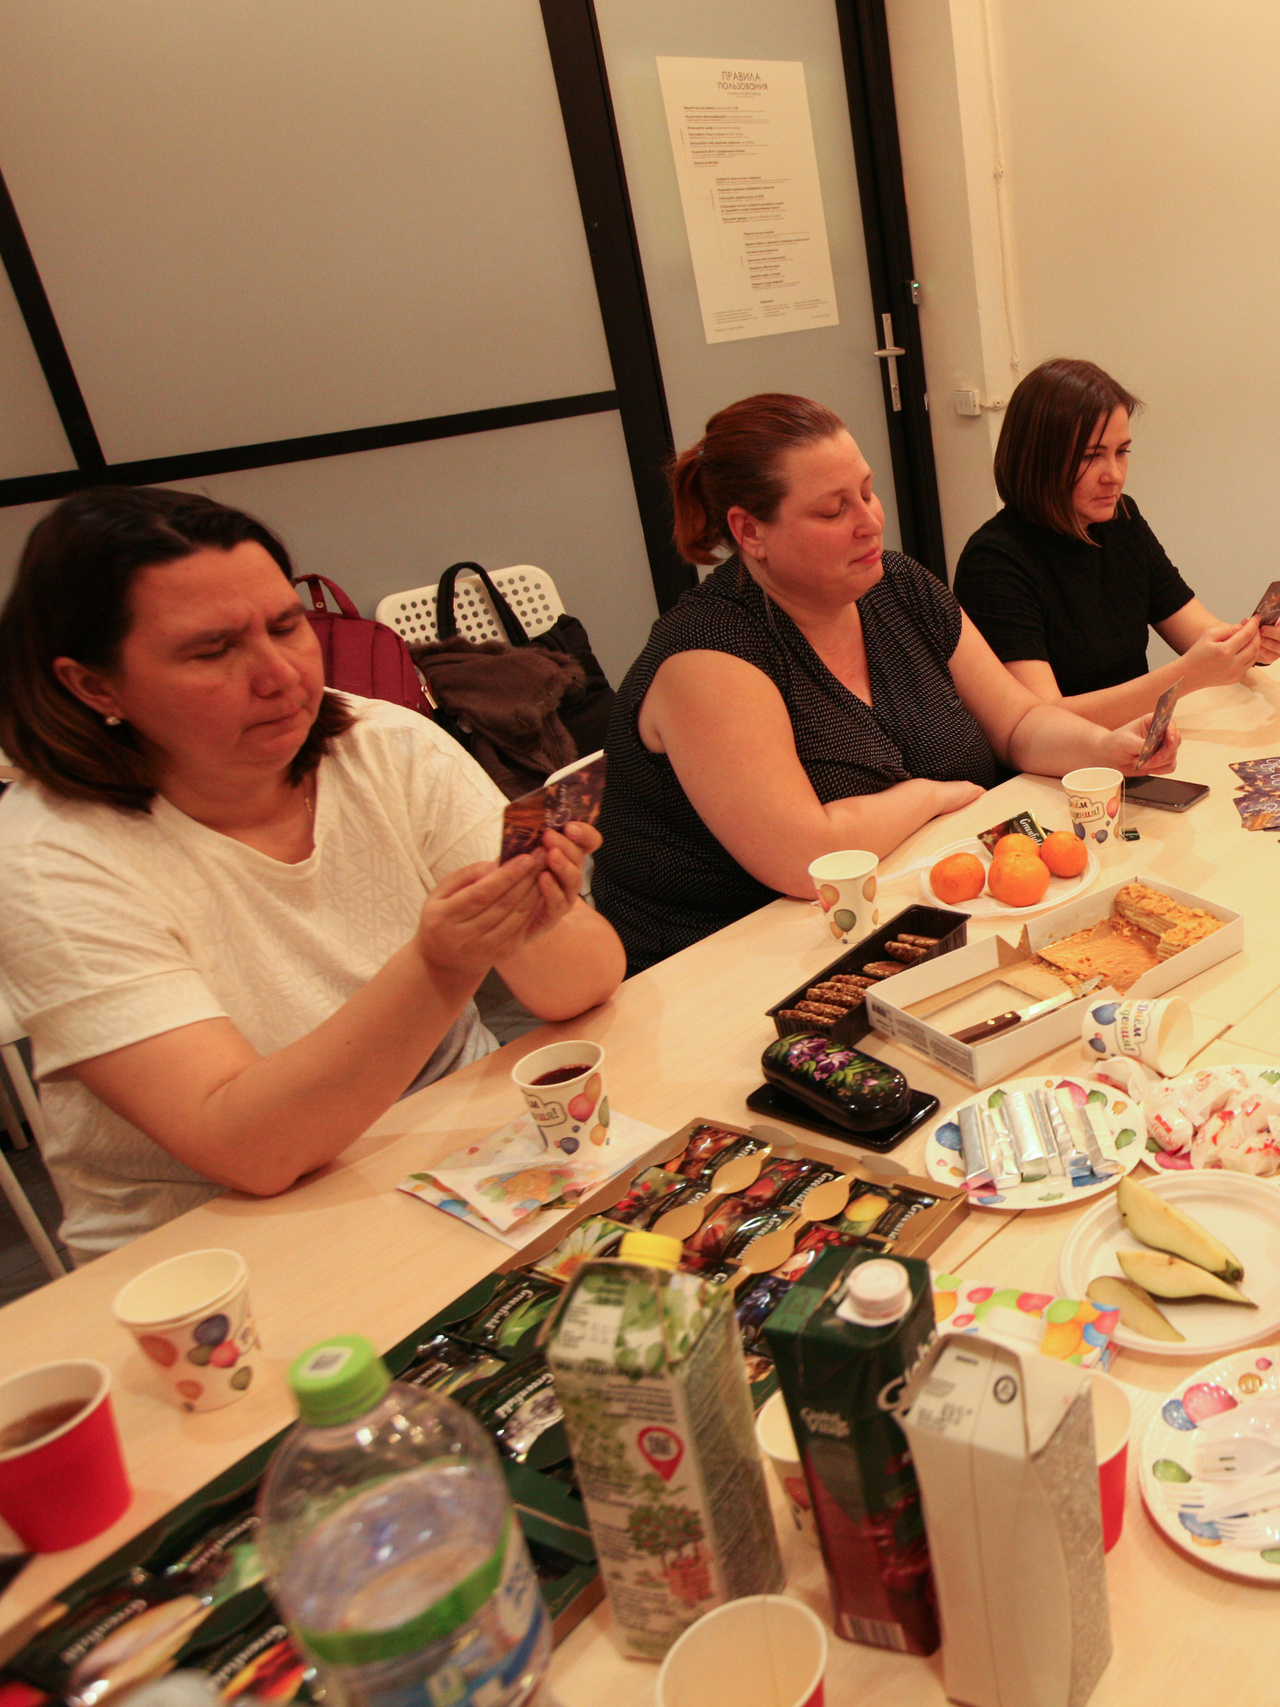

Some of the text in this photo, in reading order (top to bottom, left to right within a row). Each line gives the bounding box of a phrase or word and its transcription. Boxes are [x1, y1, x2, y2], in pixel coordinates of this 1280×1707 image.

[721, 71, 761, 81] ПРАВИЛА
[484, 1289, 534, 1330] Greenfield
[494, 1373, 555, 1419] Greenfield
